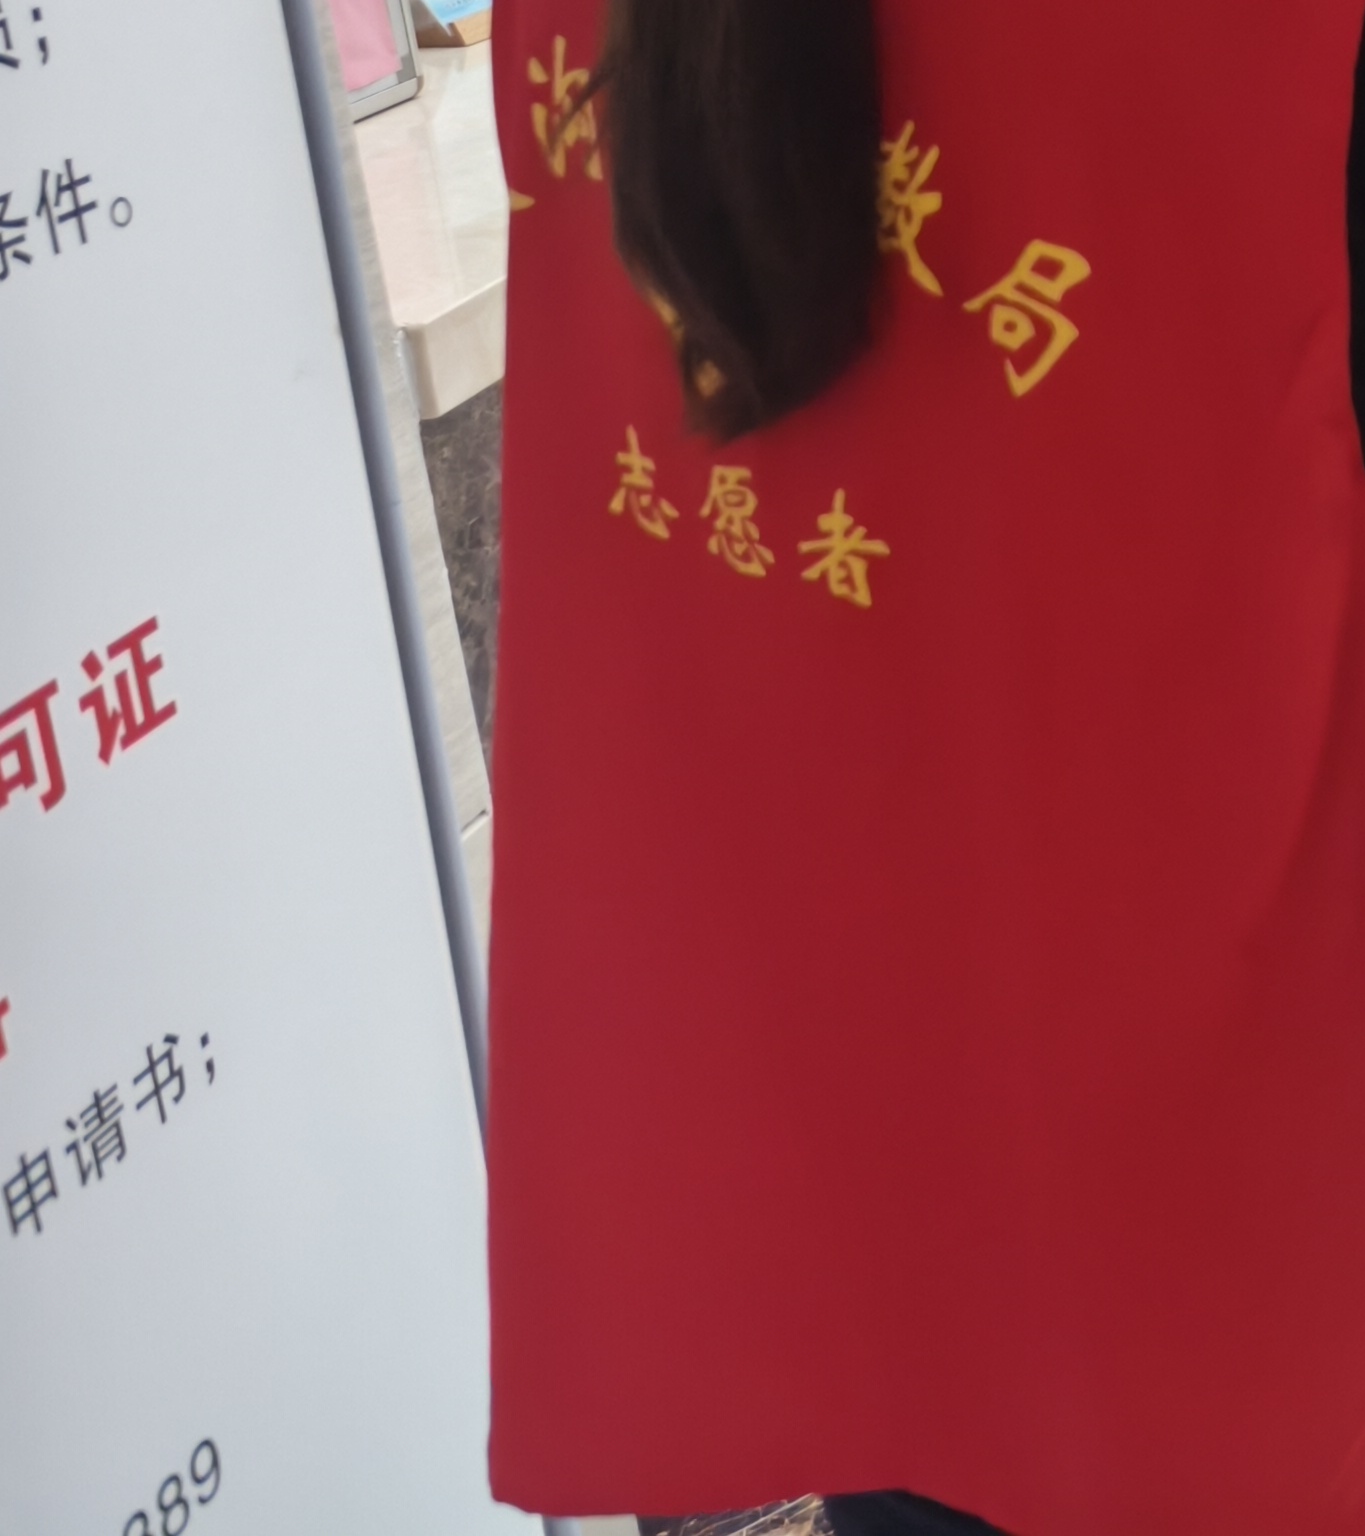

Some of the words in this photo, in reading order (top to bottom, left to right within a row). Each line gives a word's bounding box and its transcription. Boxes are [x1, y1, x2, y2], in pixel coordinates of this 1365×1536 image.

[608, 424, 891, 608] 志愿者
[0, 614, 178, 813] 可证
